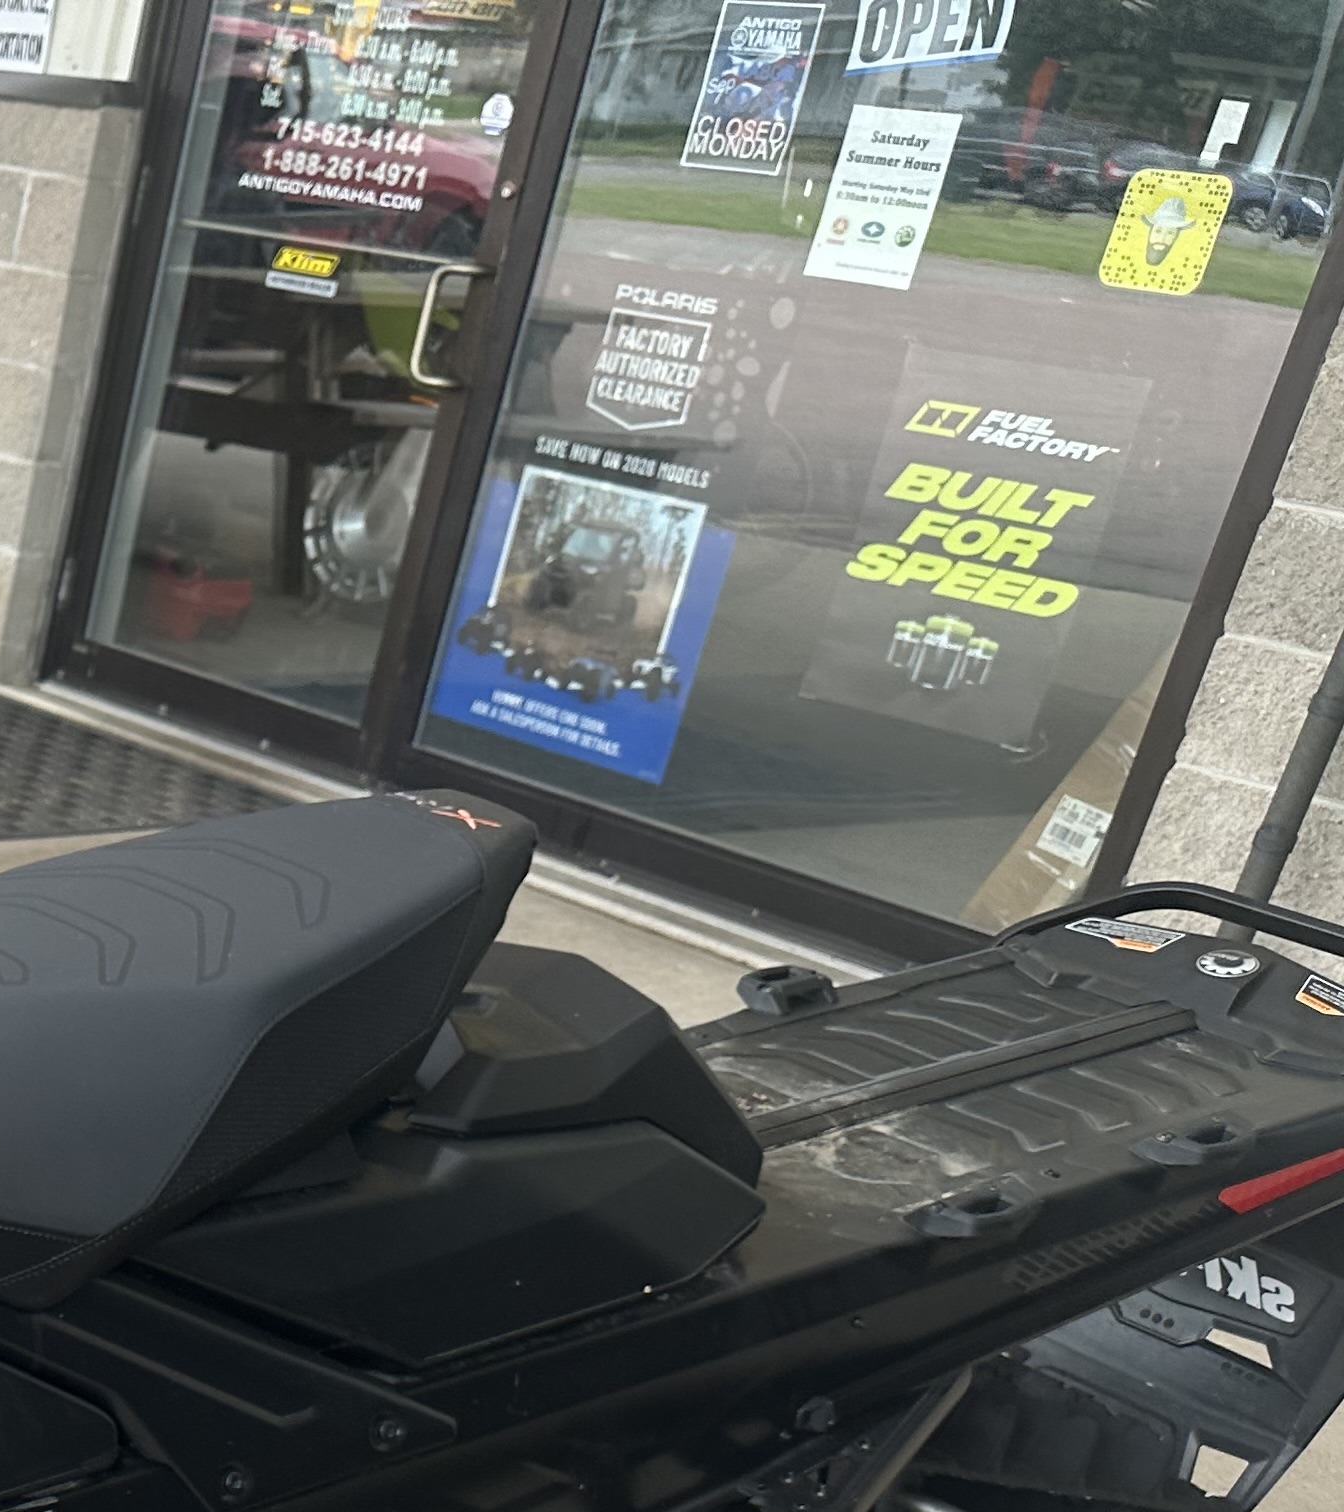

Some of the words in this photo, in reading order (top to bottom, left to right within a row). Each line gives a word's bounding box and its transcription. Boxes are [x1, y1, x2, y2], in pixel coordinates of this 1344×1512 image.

[740, 16, 802, 31] ANTIGO
[747, 29, 802, 50] YAMAHA
[859, 0, 1005, 63] OPEN
[276, 116, 426, 157] 715-623-4144
[688, 132, 785, 161] MONDAY
[697, 115, 786, 143] CLOSED
[871, 130, 930, 151] Saturday
[262, 147, 428, 190] 1-888-261-4971
[846, 150, 901, 168] Summer
[902, 156, 942, 172] Hours
[238, 172, 424, 212] ANTIGOYAMAHA.COM
[615, 284, 718, 315] POLARIS
[616, 324, 693, 359] FACTORY
[594, 350, 701, 388] AUTHORIZED
[597, 377, 685, 412] CLEARANCE
[980, 409, 1055, 436] FUEL
[535, 434, 569, 459] SAVE
[569, 442, 602, 465] NOW
[601, 450, 623, 470] ON
[657, 461, 711, 489] MODELS
[967, 425, 1110, 462] FACTORY
[884, 462, 1096, 528] BUILT
[896, 508, 1053, 569] FOR
[845, 543, 1079, 618] SPEED
